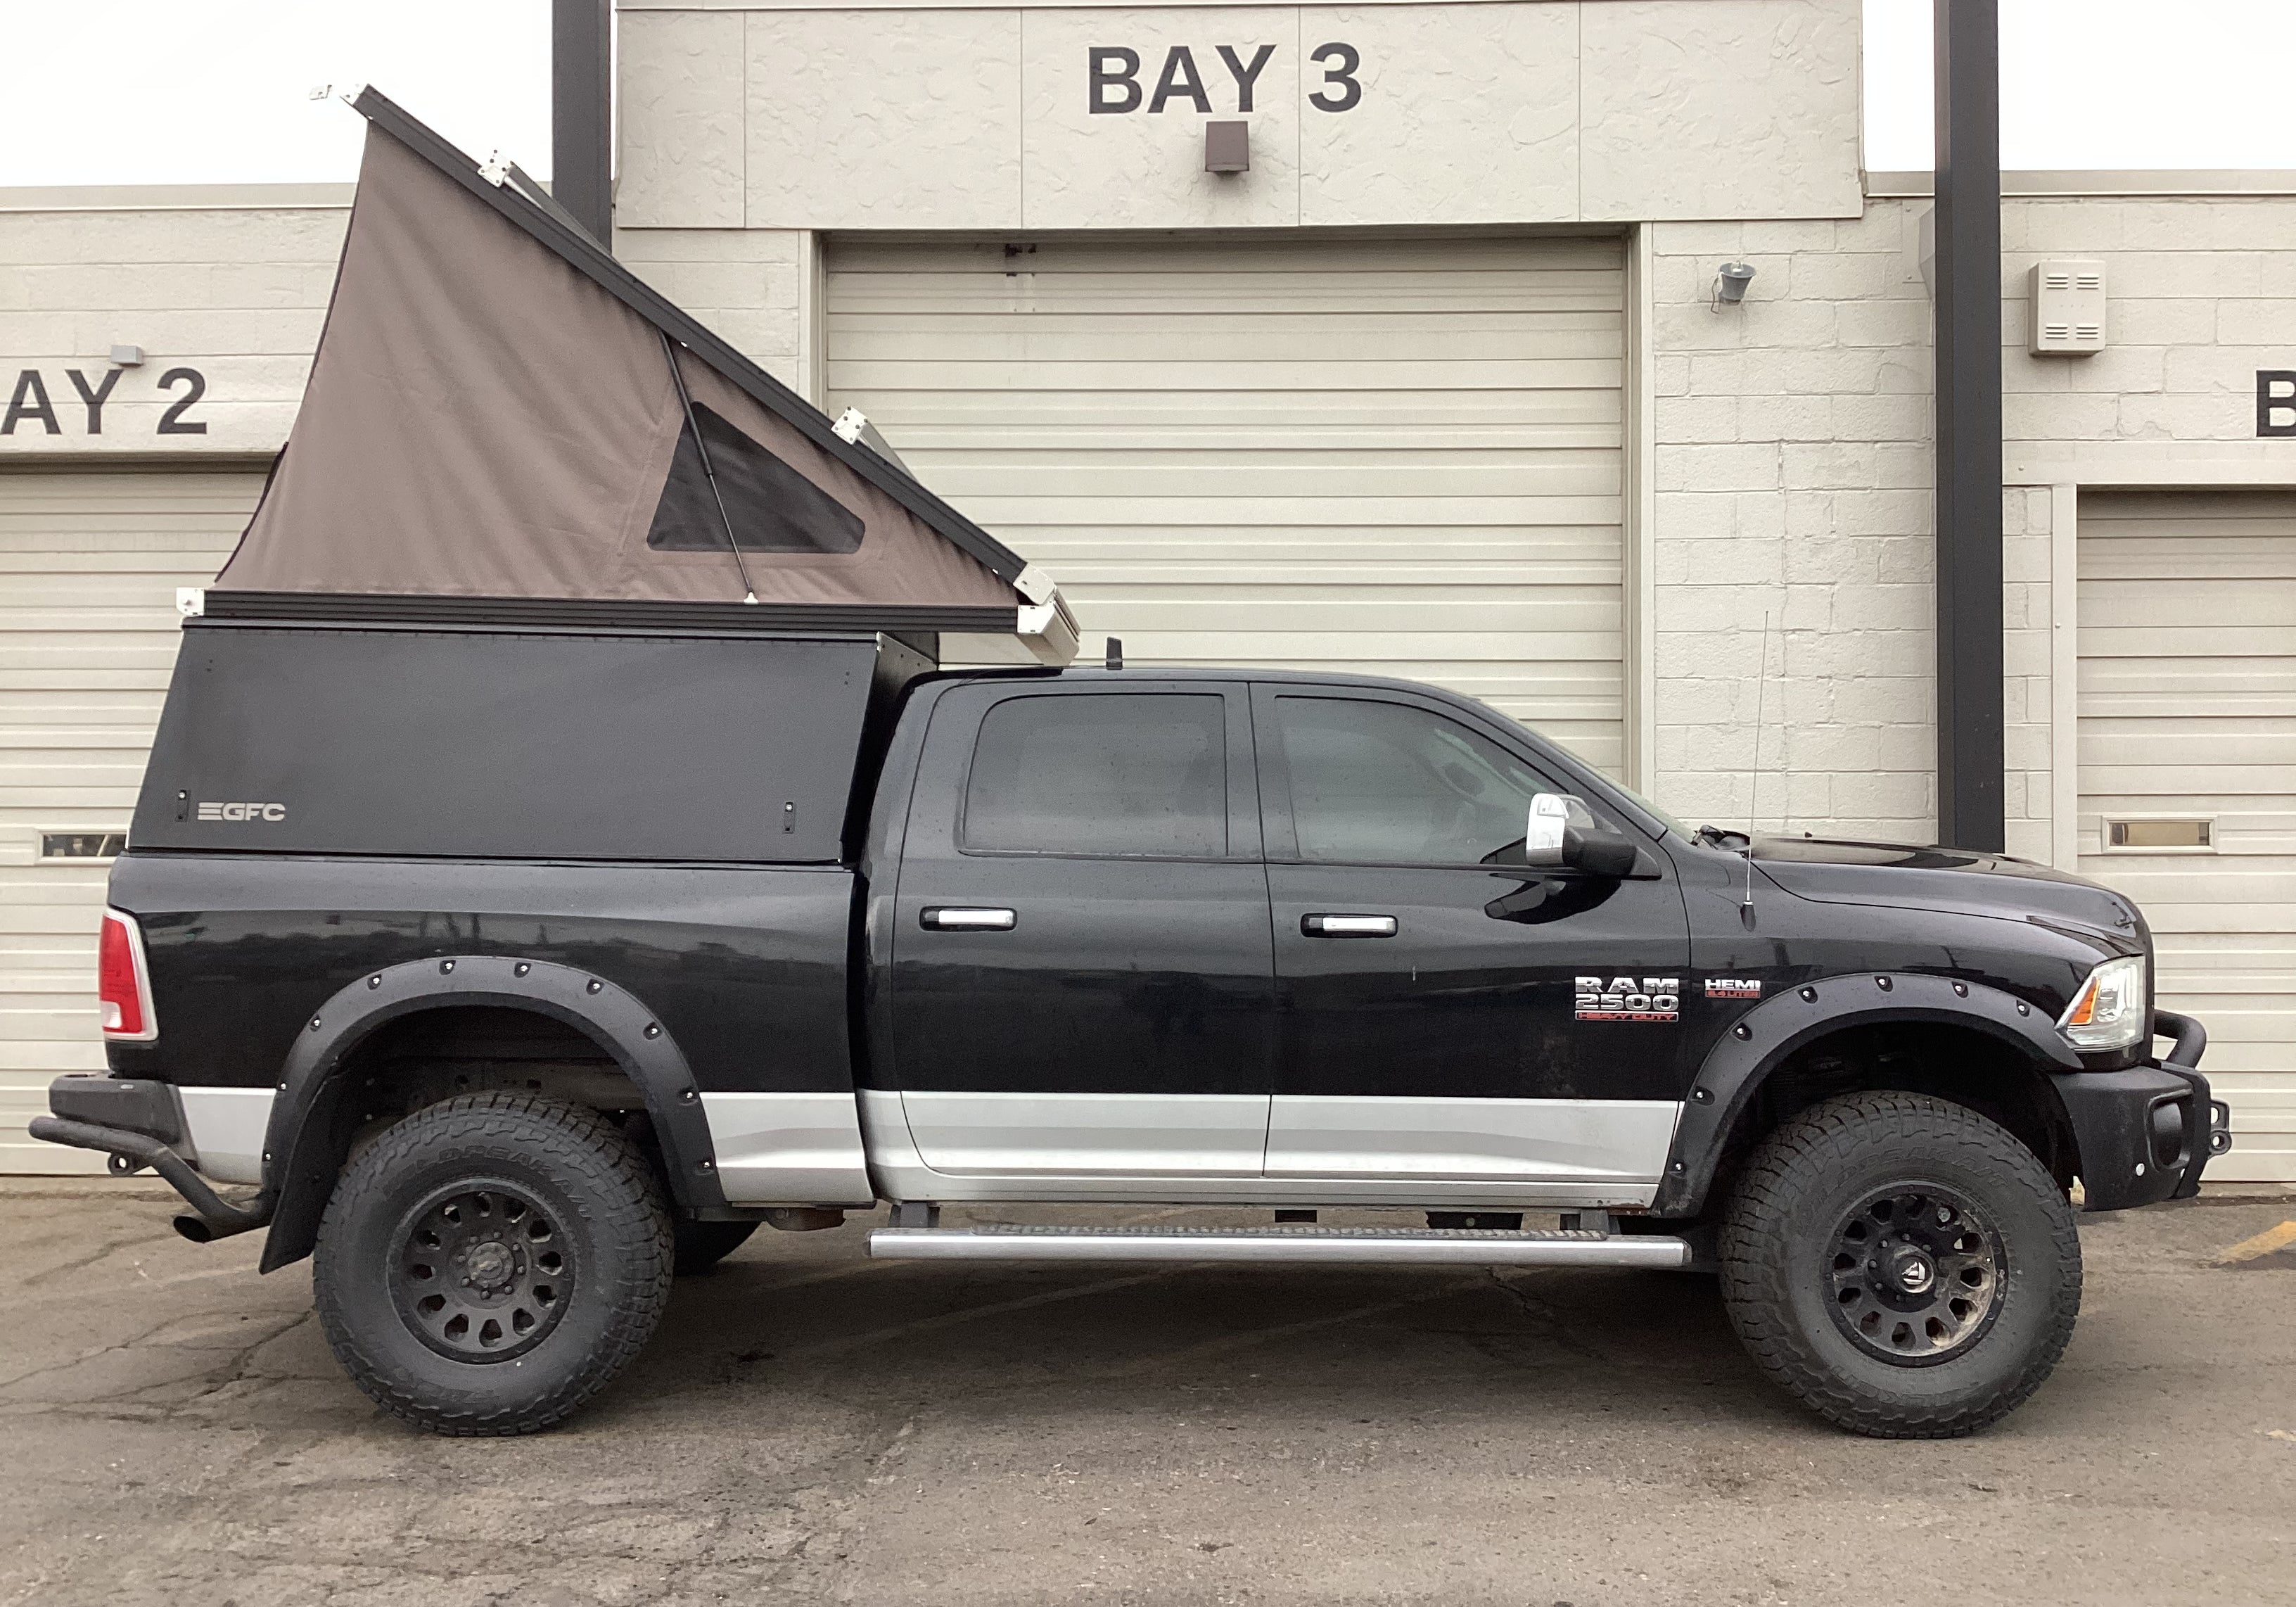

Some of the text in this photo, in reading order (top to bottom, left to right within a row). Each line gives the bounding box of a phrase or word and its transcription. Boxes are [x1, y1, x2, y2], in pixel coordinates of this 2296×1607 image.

[1089, 42, 1362, 114] BAY 3
[156, 367, 208, 435] 2
[1575, 977, 1679, 993] RAM
[1704, 979, 1761, 989] HEMI
[1575, 993, 1679, 1011] 2500
